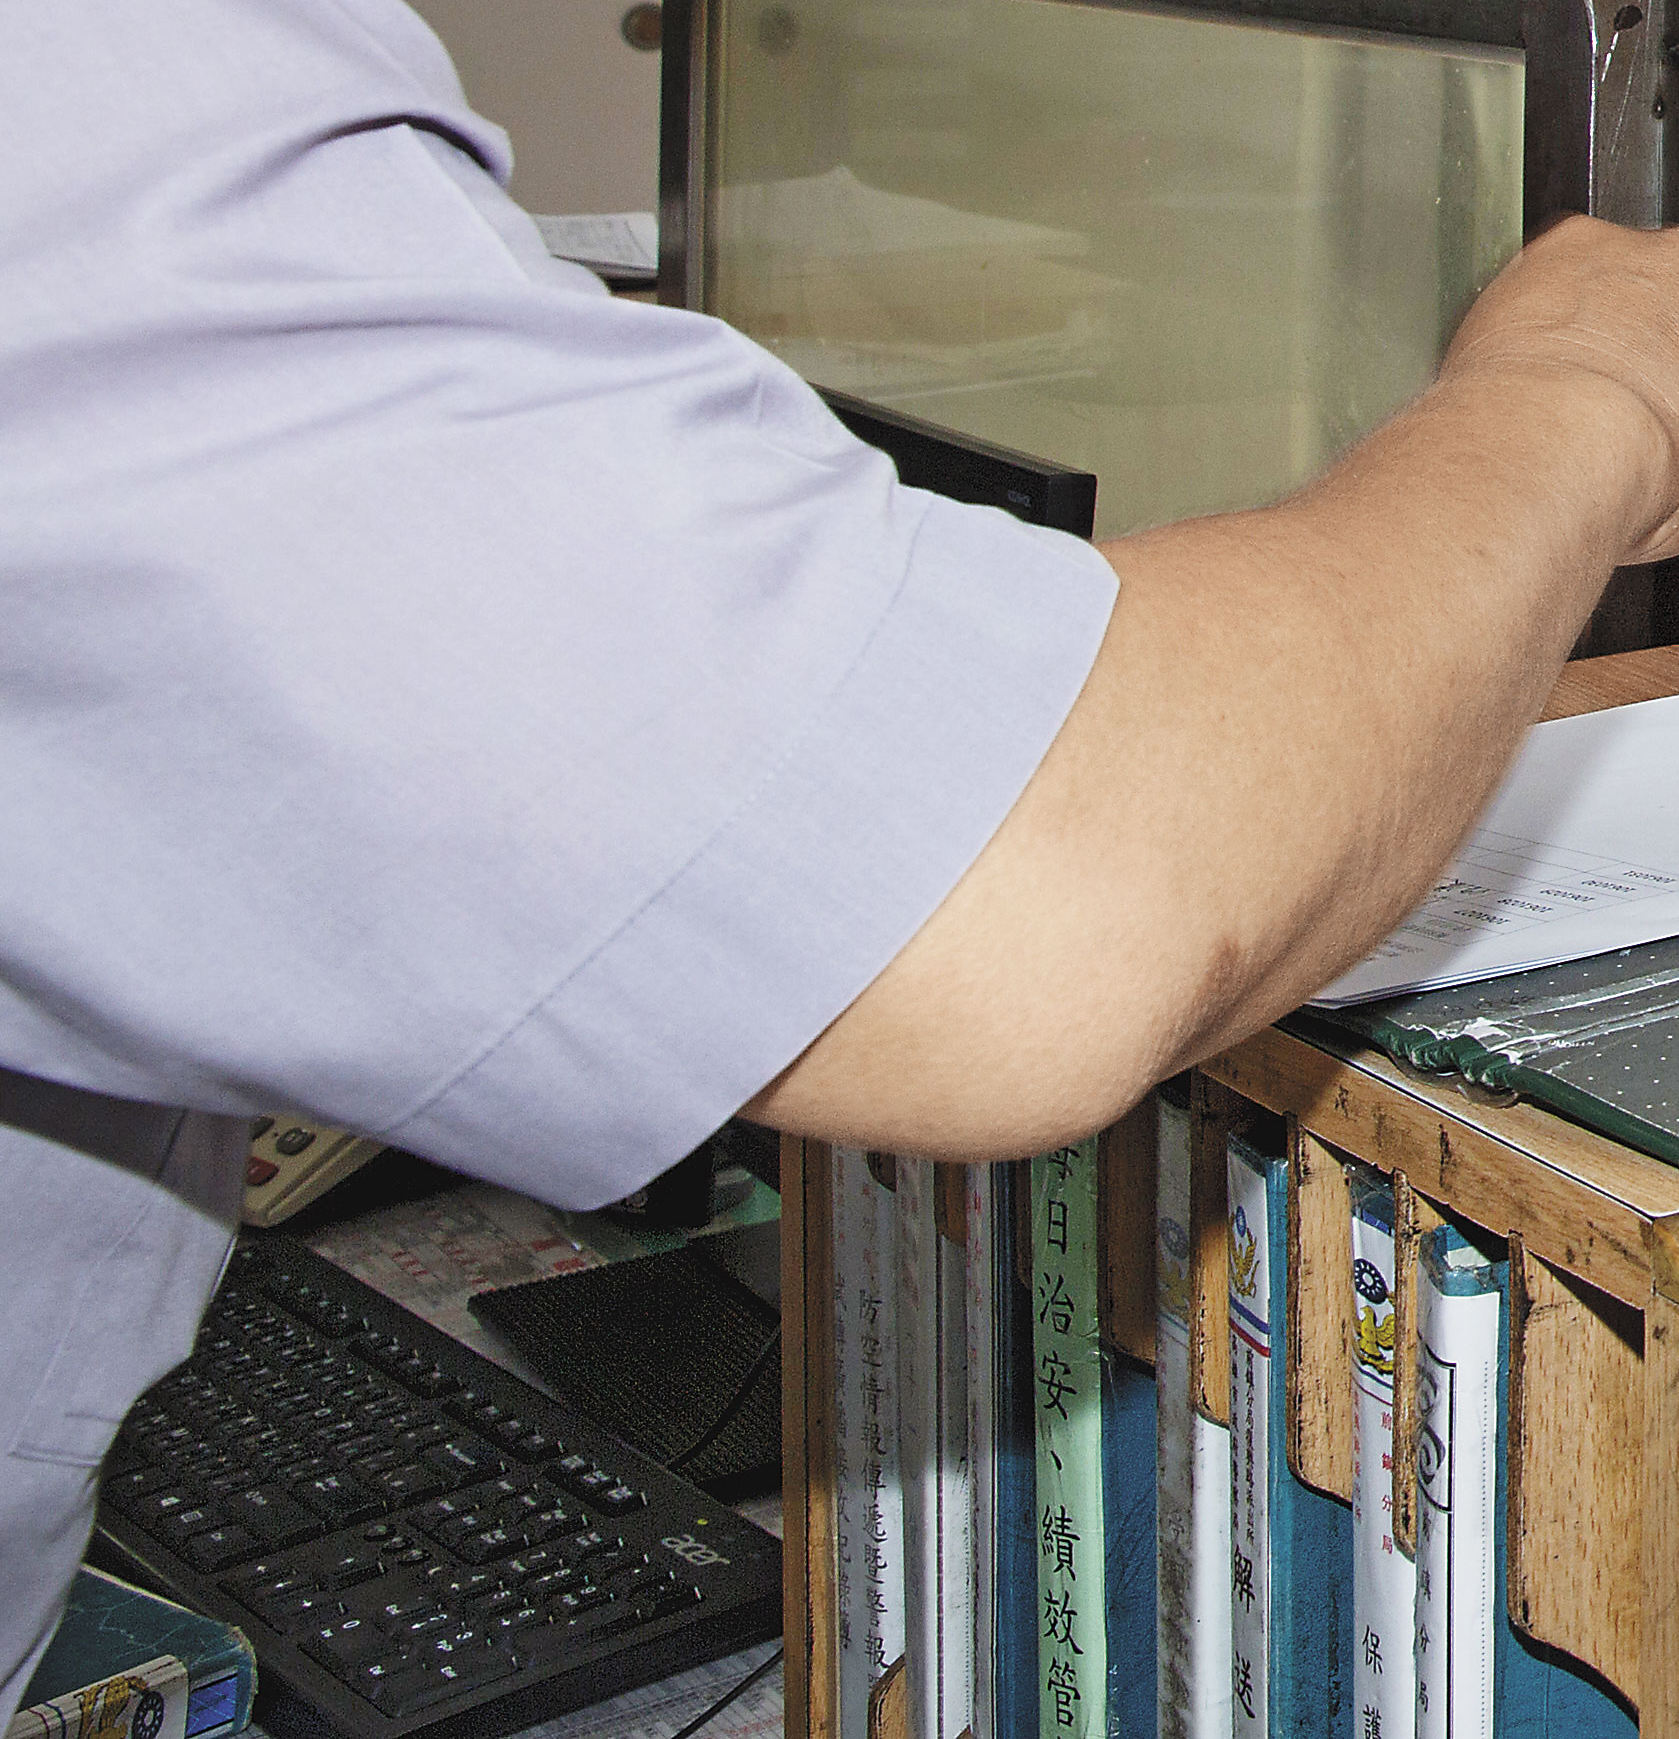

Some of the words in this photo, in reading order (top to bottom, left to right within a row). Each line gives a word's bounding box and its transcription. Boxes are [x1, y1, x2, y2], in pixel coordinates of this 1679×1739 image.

[661, 1534, 731, 1566] acer
[1039, 1147, 1084, 1739] 日治安、績效管
